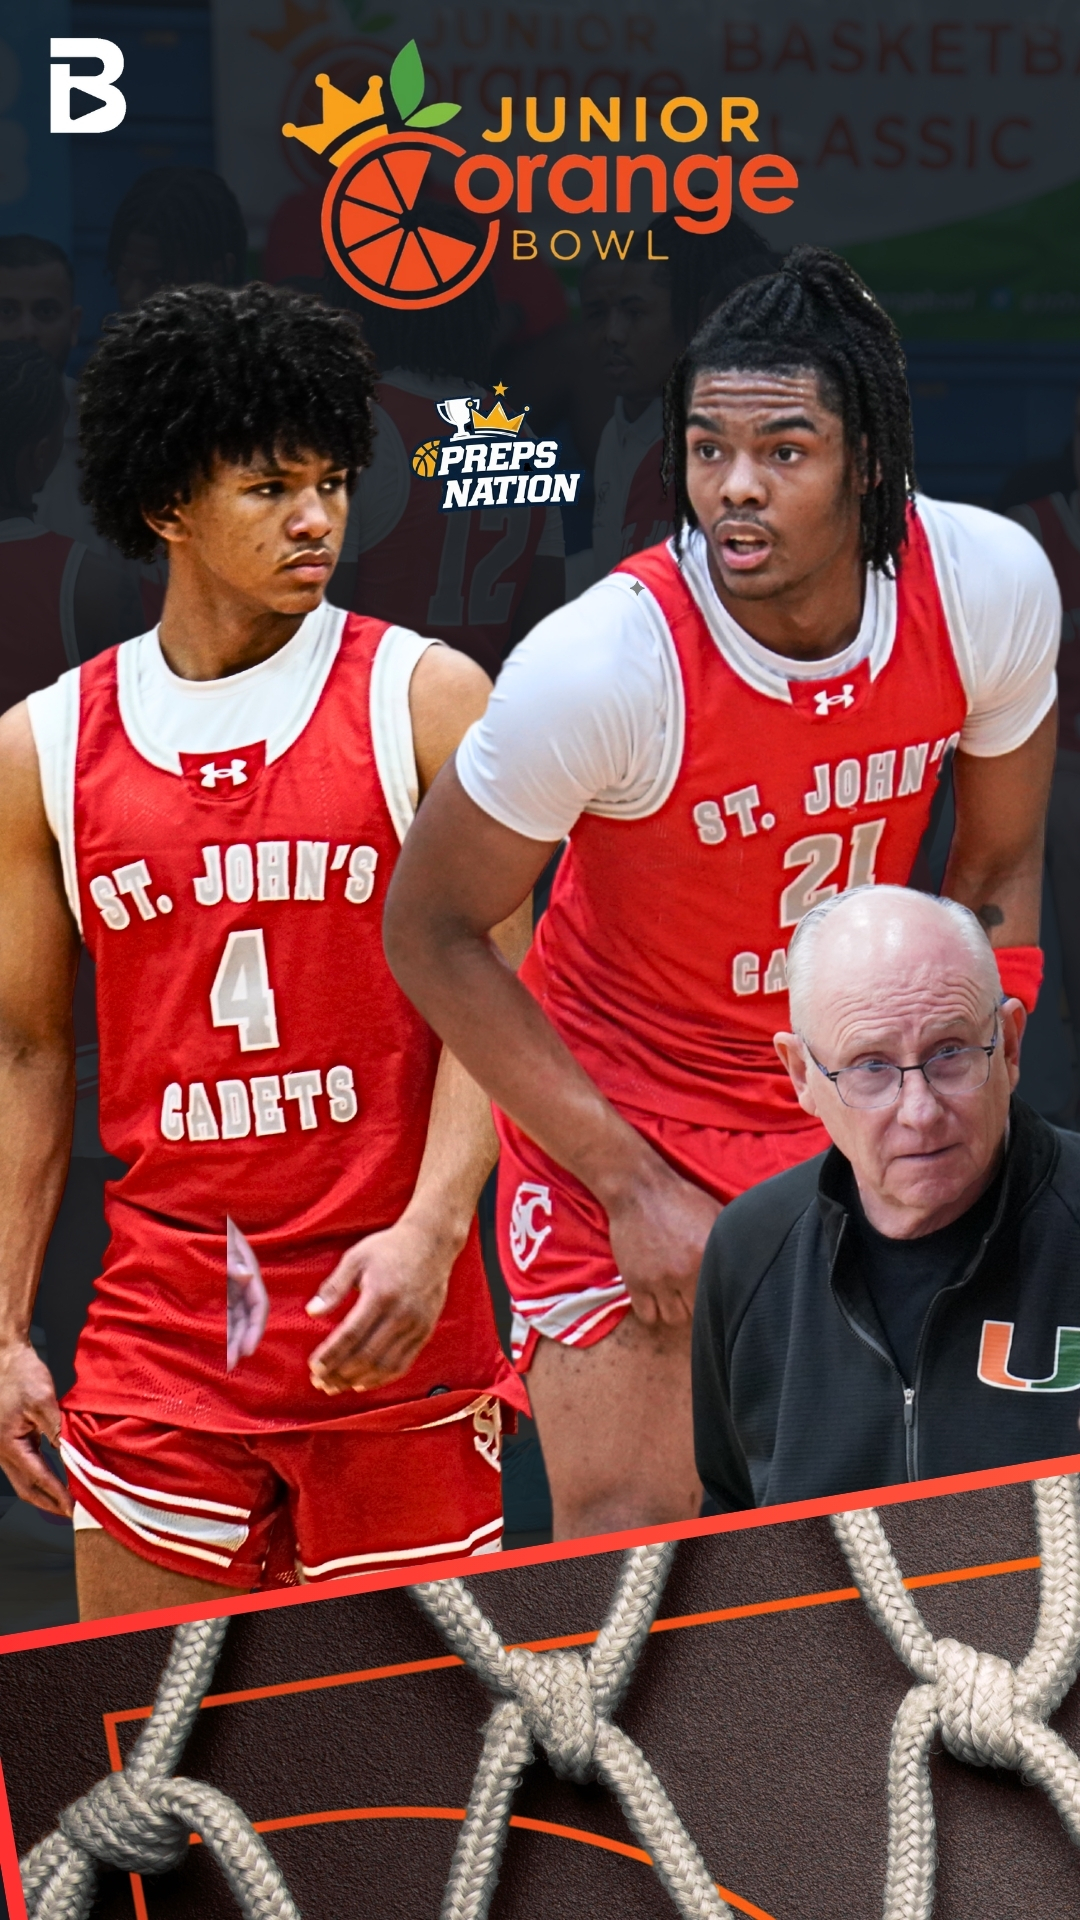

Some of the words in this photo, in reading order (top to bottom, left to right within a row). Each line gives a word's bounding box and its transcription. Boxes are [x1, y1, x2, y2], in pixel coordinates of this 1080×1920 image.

[421, 9, 658, 54] JUNIOR
[722, 19, 1080, 75] BASKETB
[426, 507, 532, 627] 12
[692, 784, 776, 845] ST.
[89, 859, 173, 930] ST.
[192, 840, 378, 906] JOHN'S
[779, 817, 887, 929] 21
[209, 928, 280, 1053] 4
[160, 1064, 358, 1142] CADETS
[977, 1319, 1080, 1393] U
